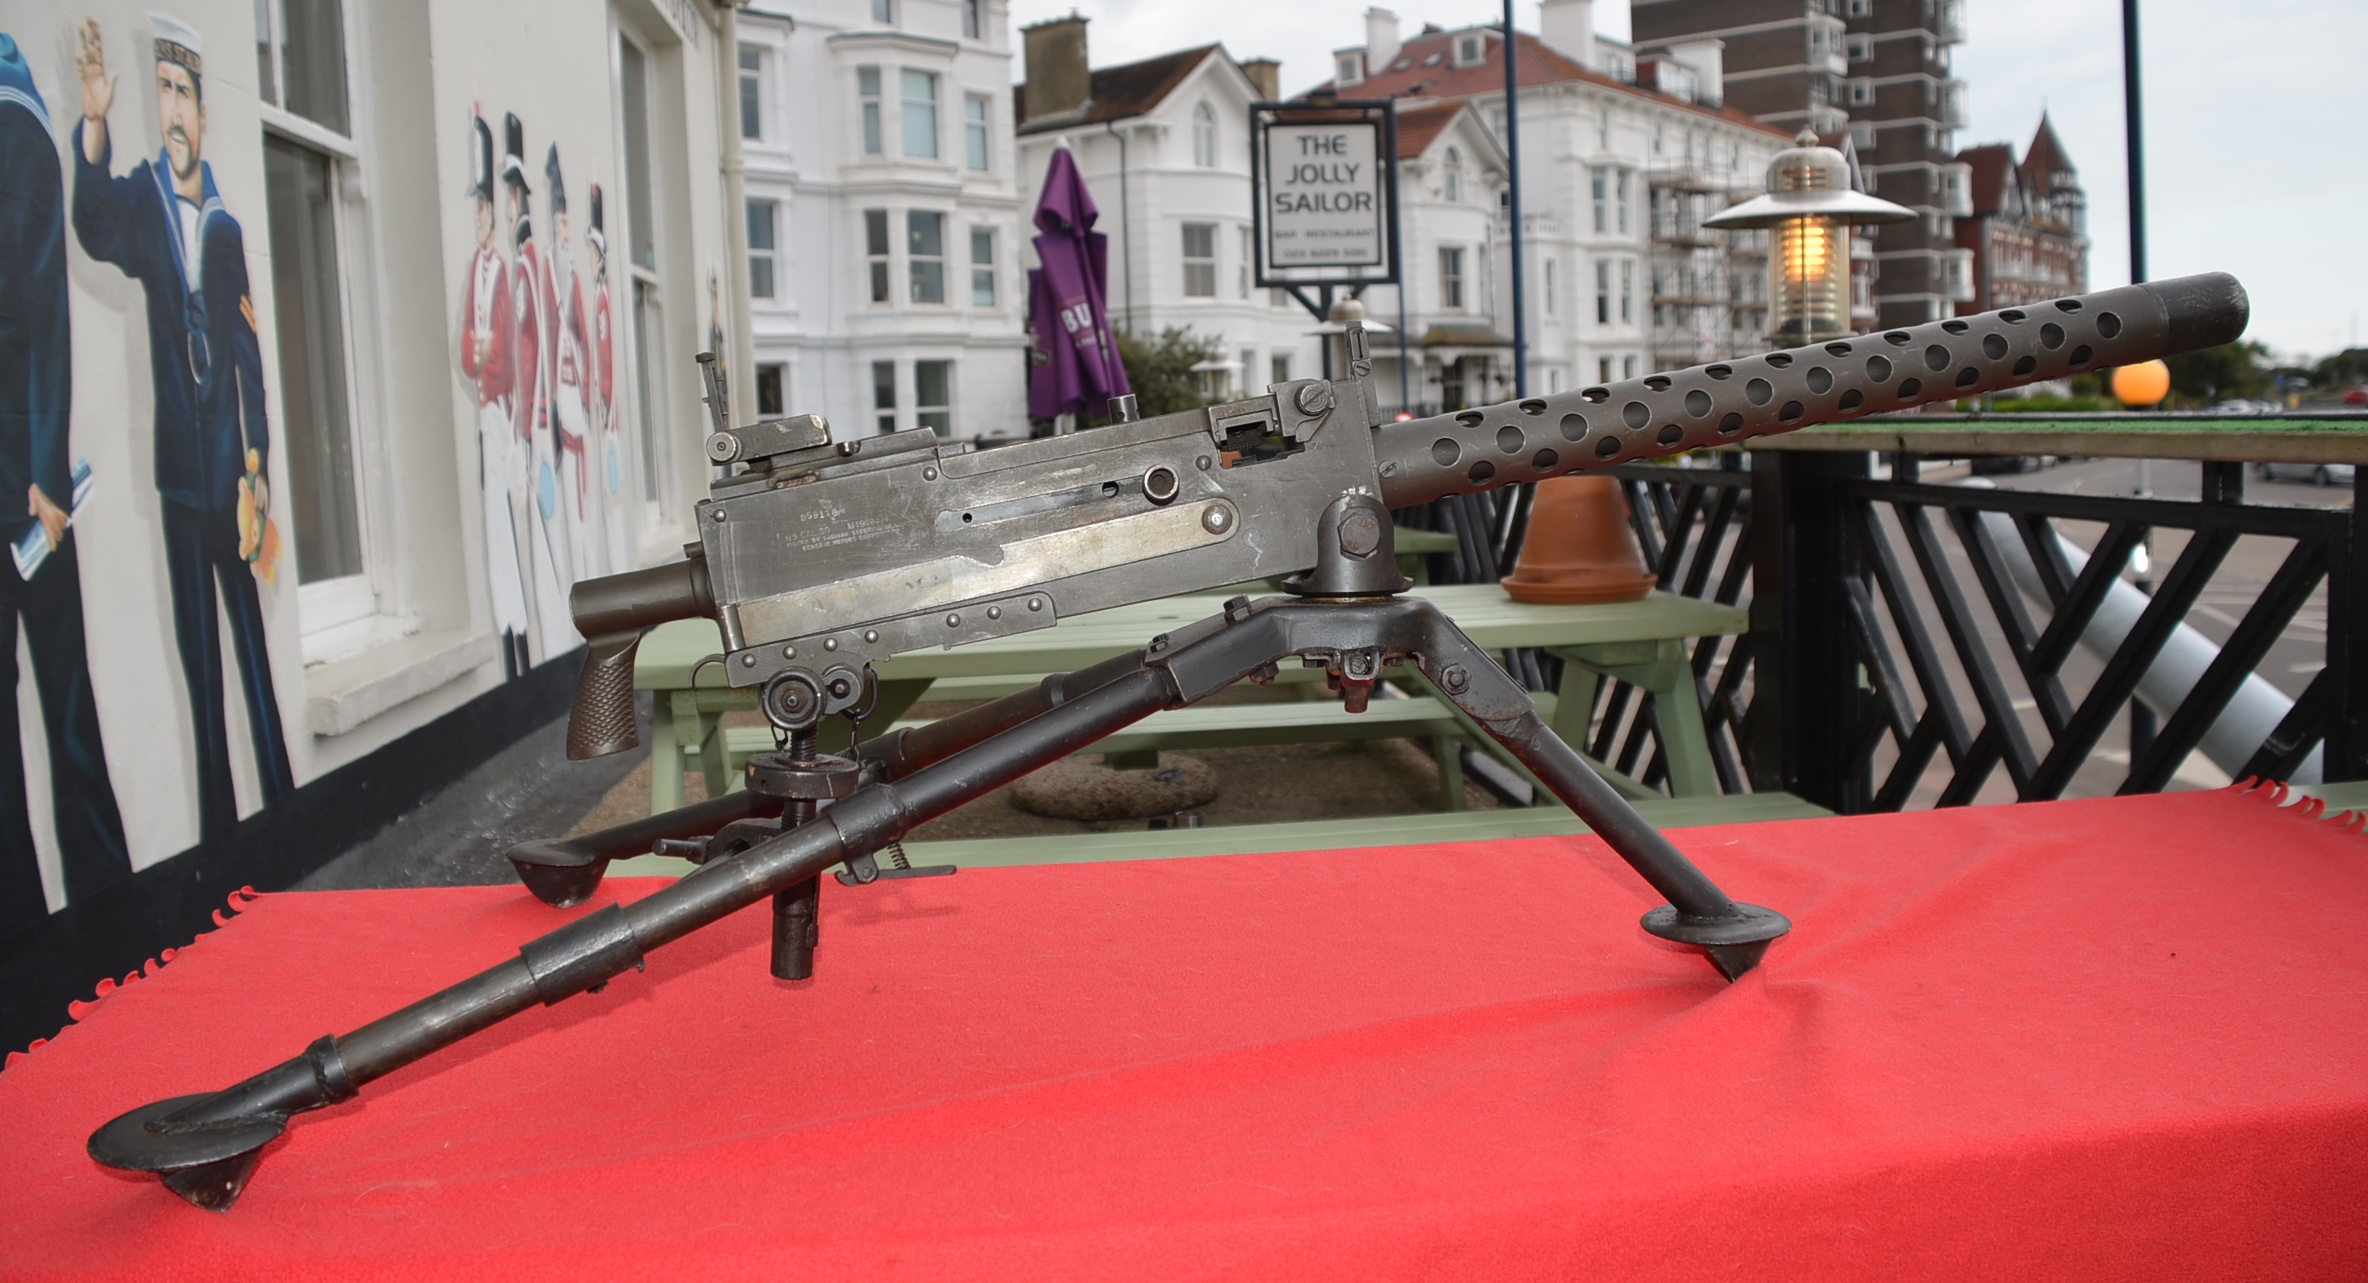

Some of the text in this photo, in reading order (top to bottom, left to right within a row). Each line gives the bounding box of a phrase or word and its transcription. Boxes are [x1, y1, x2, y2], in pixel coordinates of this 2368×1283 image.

[1297, 134, 1348, 156] THE
[1285, 163, 1361, 186] JOLLY
[1275, 191, 1373, 214] SAILOR
